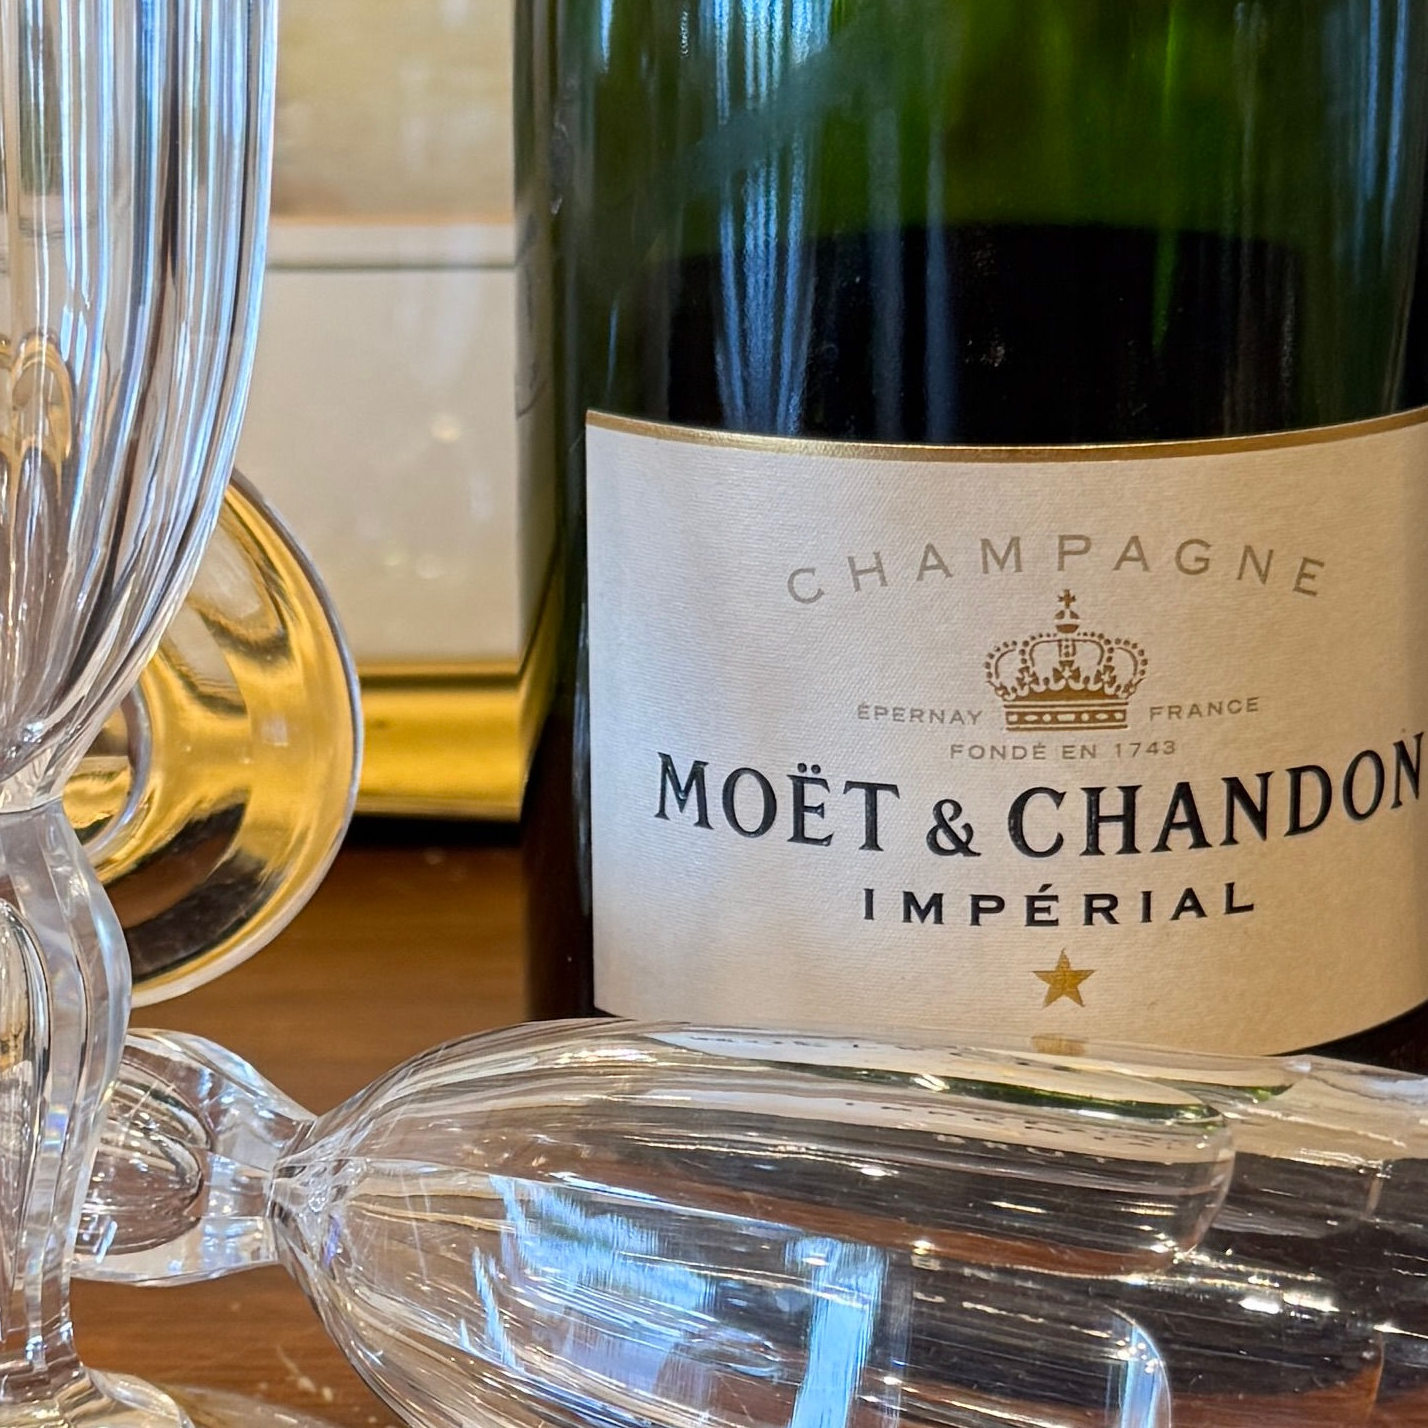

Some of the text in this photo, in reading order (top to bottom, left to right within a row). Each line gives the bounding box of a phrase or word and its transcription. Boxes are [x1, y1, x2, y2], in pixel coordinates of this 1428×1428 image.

[787, 534, 1325, 605] CHAMPAGNE
[857, 697, 1260, 726] ÉPERNAY FRANCE
[950, 741, 1176, 761] FONDÉ EN 1743
[655, 732, 1425, 858] MOËT & CHANDON
[863, 882, 1255, 927] IMPÉRIAL
